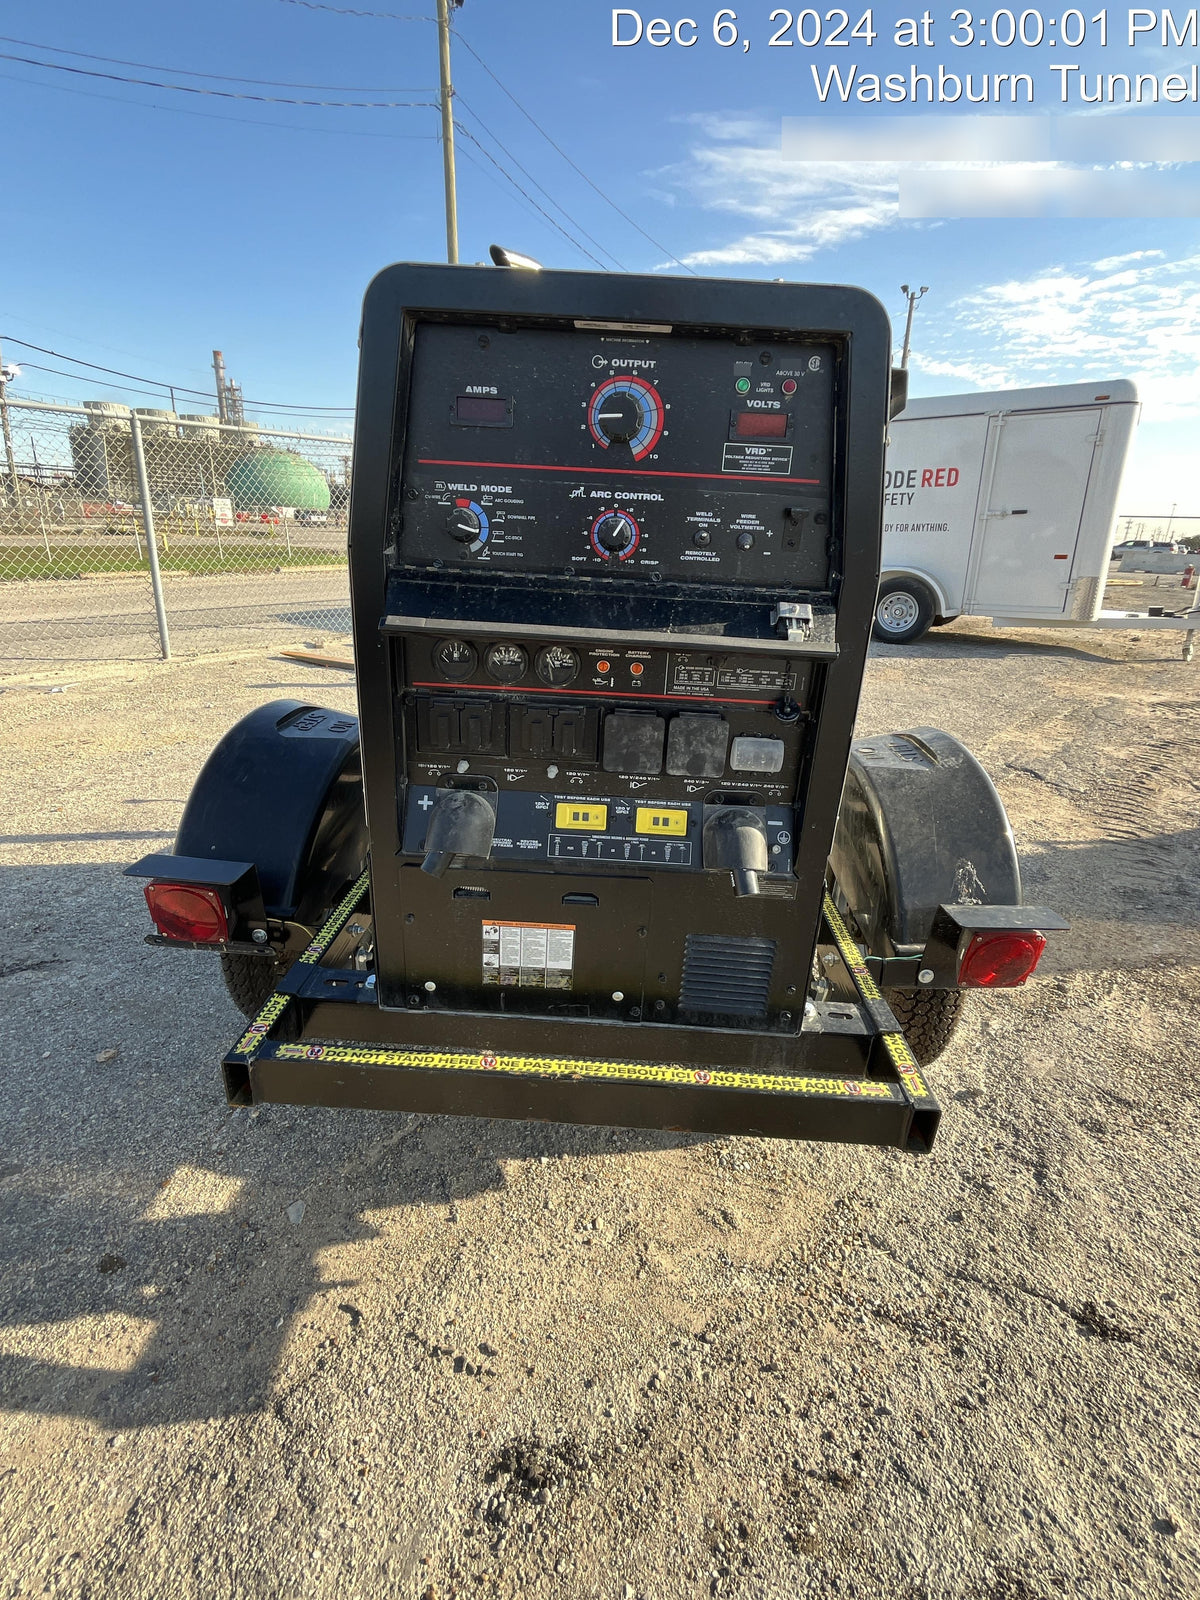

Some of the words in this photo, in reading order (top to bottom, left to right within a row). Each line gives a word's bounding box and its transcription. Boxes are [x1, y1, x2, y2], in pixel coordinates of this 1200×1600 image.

[611, 358, 656, 369] OUTPUT
[465, 385, 498, 395] AMPS
[746, 399, 781, 409] VOLTS
[921, 467, 960, 488] RED
[448, 482, 478, 492] WELD
[480, 484, 513, 494] MODE
[590, 490, 612, 499] ARC
[614, 491, 665, 502] CONTROL
[895, 523, 909, 532] FOR
[910, 522, 950, 532] ANYTHING.
[888, 1032, 900, 1046] NO
[324, 1049, 348, 1057] DO
[351, 1052, 381, 1061] NOT
[384, 1053, 435, 1064] STAND
[438, 1056, 479, 1067] HERE
[894, 1047, 908, 1062] DO
[499, 1060, 520, 1068] NE
[523, 1061, 552, 1070] PAS
[556, 1062, 603, 1073] TENEZ
[606, 1065, 669, 1078] DEBOUT
[670, 1069, 691, 1079] ICI
[713, 1075, 736, 1083] NO
[739, 1076, 759, 1085] SE
[762, 1078, 803, 1089] PARE
